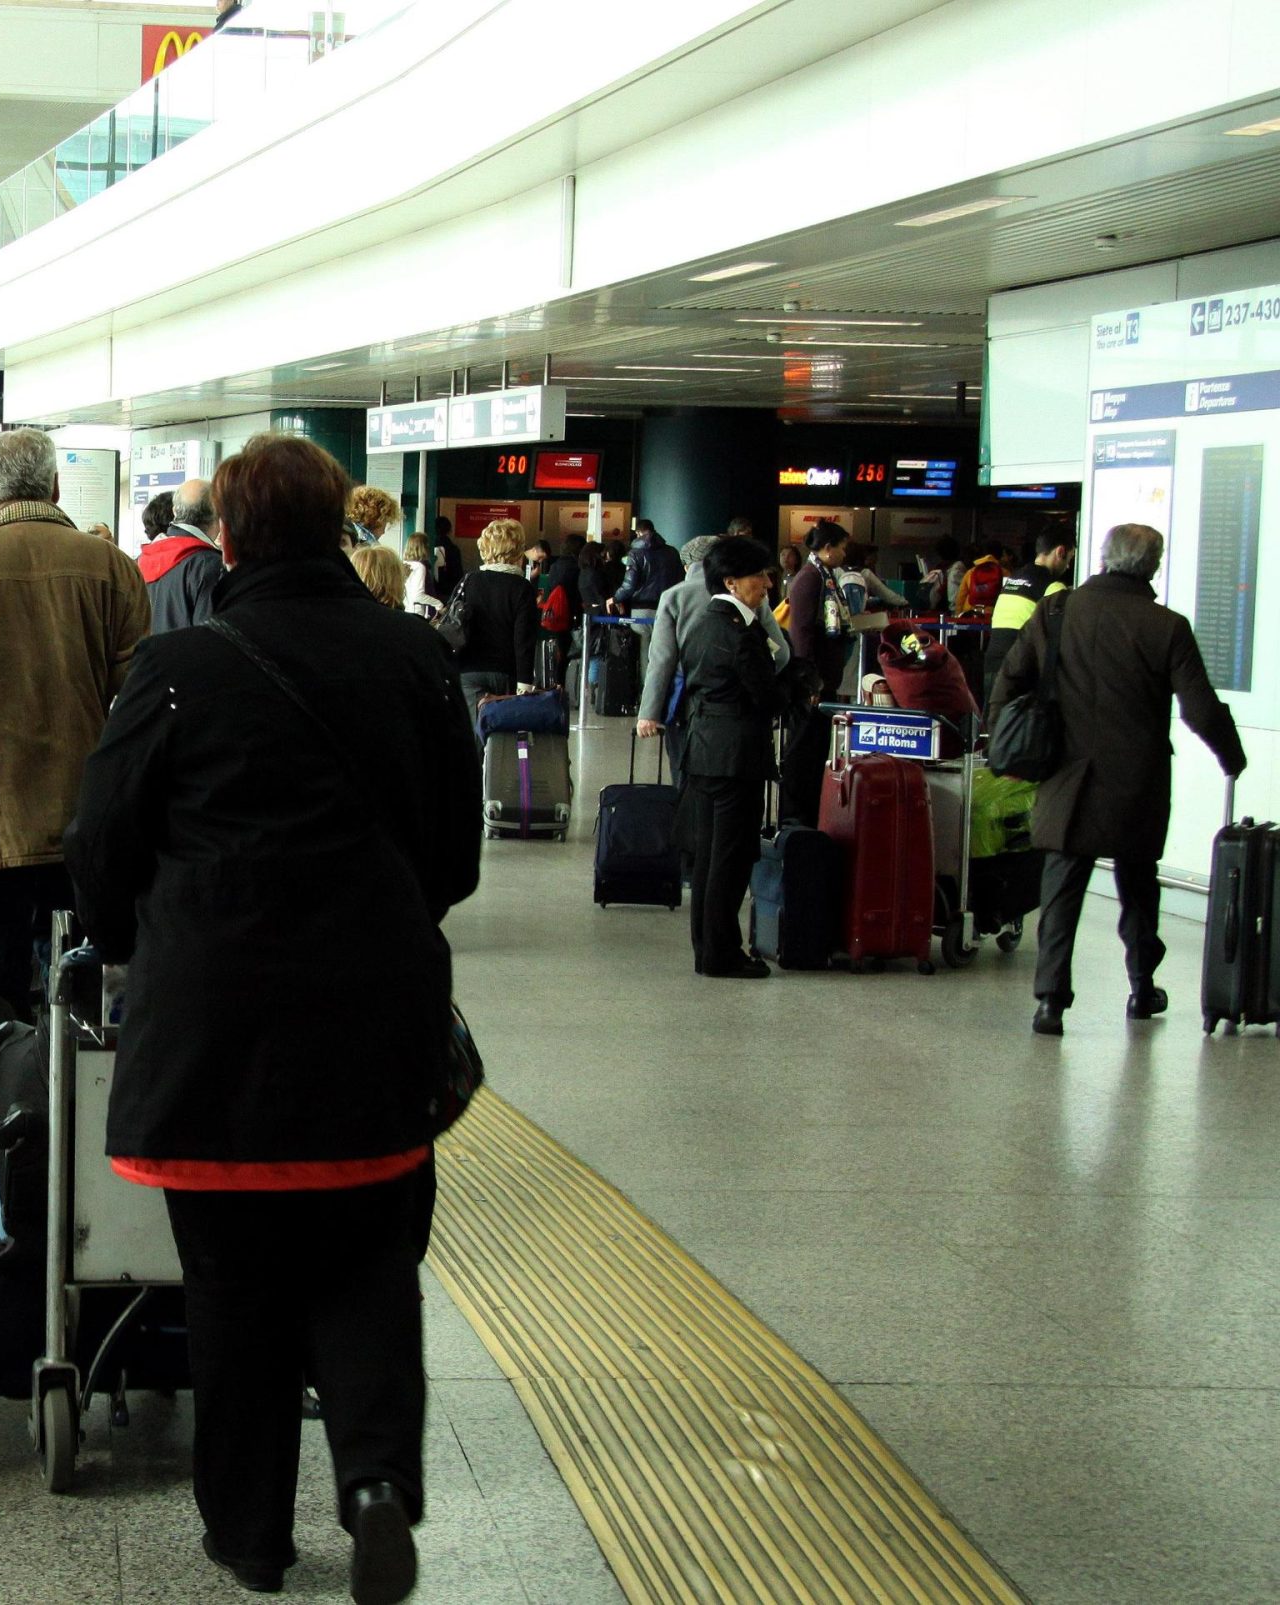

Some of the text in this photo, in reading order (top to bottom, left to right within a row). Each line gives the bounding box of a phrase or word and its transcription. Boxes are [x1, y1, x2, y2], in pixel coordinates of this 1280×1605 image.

[1225, 297, 1280, 326] 237-430
[497, 455, 526, 474] 260
[856, 464, 884, 482] 258
[877, 735, 917, 749] di Roma
